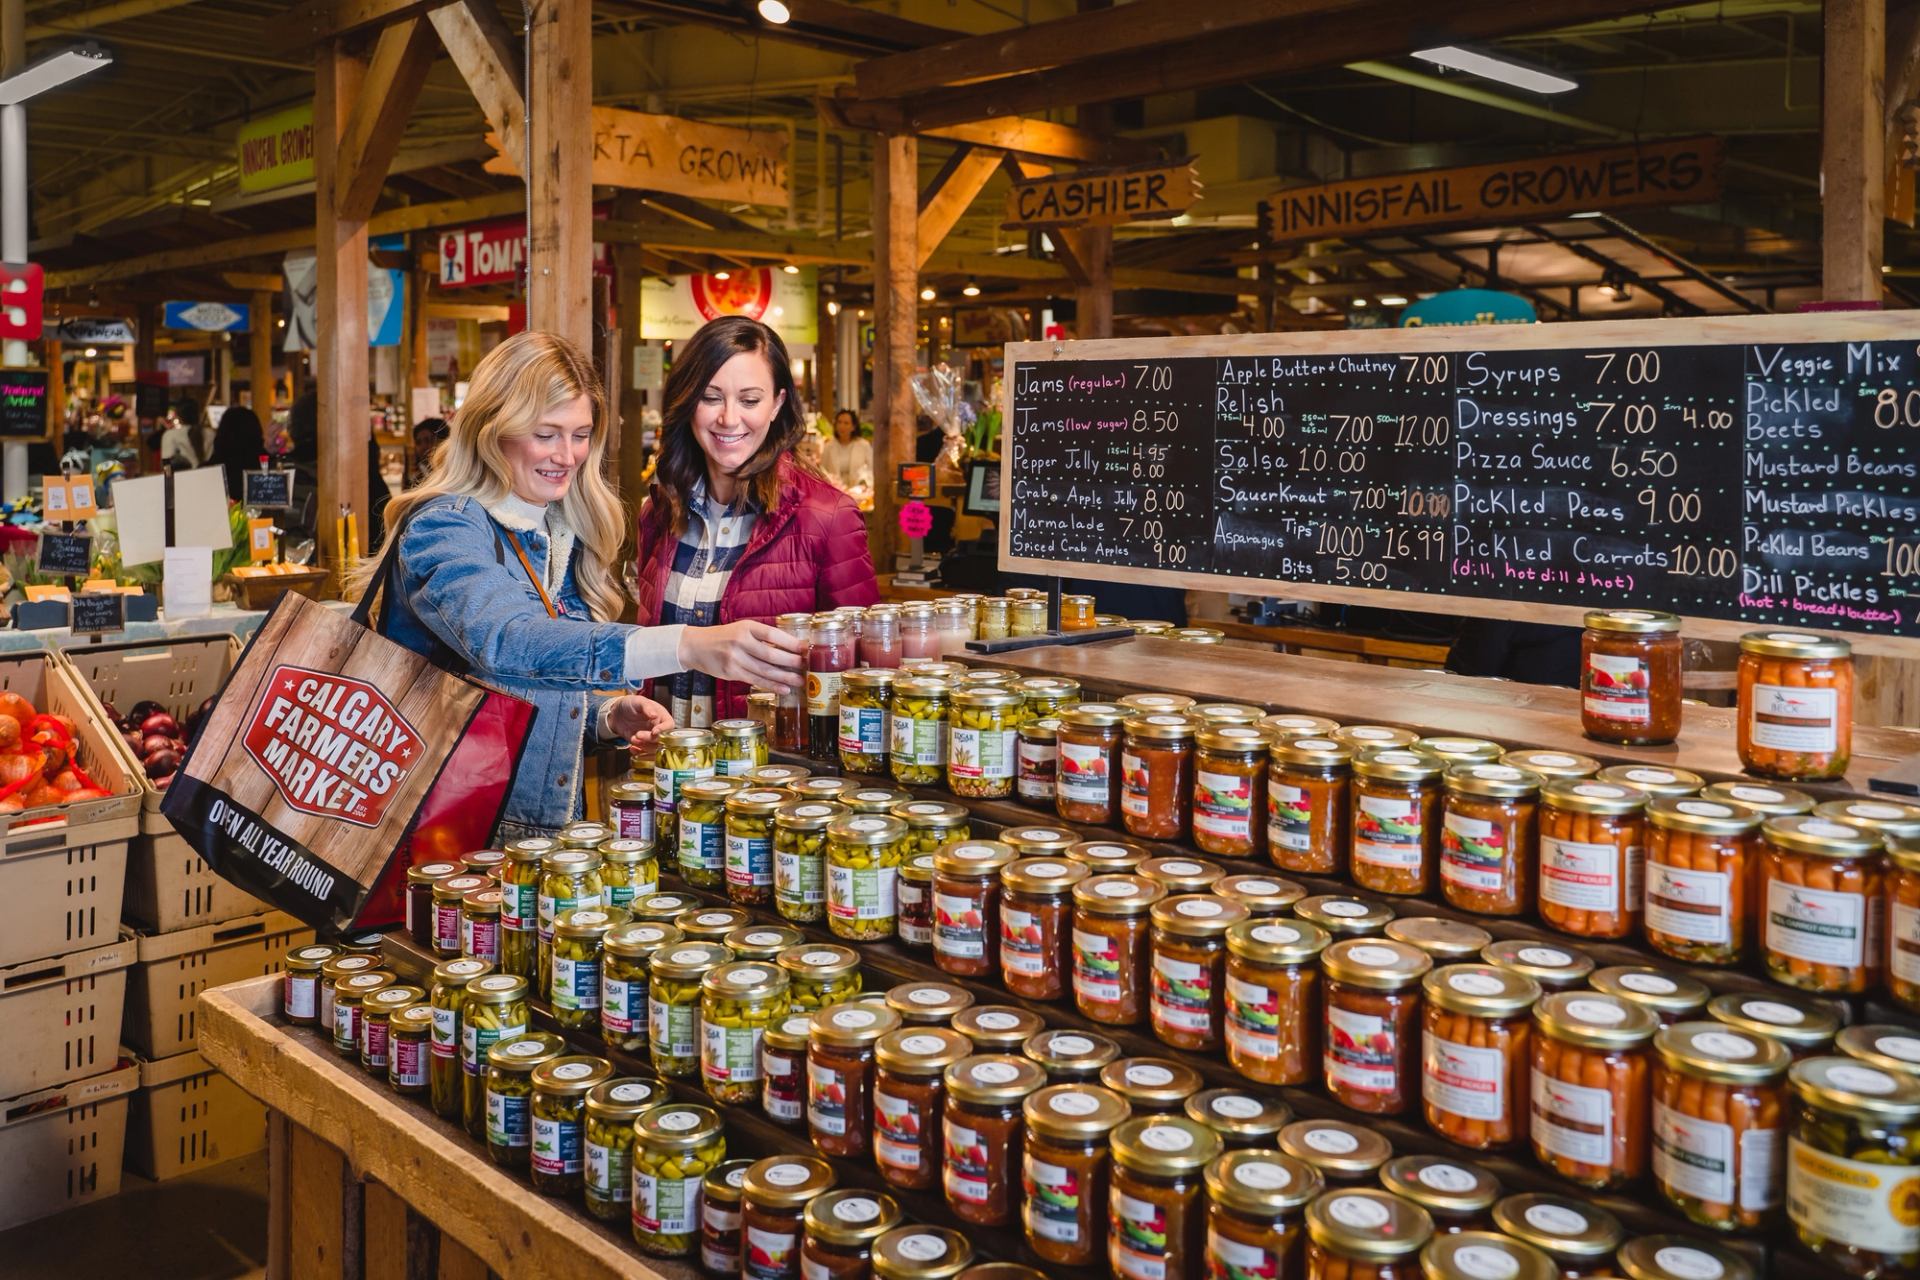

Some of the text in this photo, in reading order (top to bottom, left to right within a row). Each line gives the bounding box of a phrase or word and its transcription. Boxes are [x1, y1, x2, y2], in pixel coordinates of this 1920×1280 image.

[281, 124, 314, 166] GROWE
[679, 145, 778, 186] GROWN
[1018, 174, 1169, 220] CASHIER
[1281, 151, 1703, 232] INNISFAIL GROWERS
[468, 232, 528, 277] TOMA
[1222, 359, 1267, 382] Apple
[1273, 358, 1330, 379] Butter
[1339, 357, 1396, 381] Chutney
[1400, 356, 1448, 384] 7.00
[1466, 351, 1660, 389] Syrups 7.00
[1754, 343, 1900, 376] Veggie Mix
[1017, 365, 1172, 395] Jams (regular) 7.00
[1217, 387, 1284, 414] Relish
[1016, 408, 1179, 434] Jams (low sugar) 8.50
[1242, 415, 1285, 438] 4.00
[1330, 415, 1373, 443] 7.00
[1458, 399, 1577, 434] Dressings
[1588, 402, 1656, 433] 7.00
[1683, 408, 1733, 429] 4.00
[1746, 412, 1823, 440] Beets
[1014, 445, 1057, 474] Pepper
[1065, 448, 1099, 475] Jelly
[1132, 447, 1168, 461] 4.95
[1132, 463, 1164, 478] 8.00
[1220, 445, 1366, 472] Salsa 10.00
[1457, 442, 1677, 477] Pizza Sauce 6.50
[1746, 452, 1917, 478] Mustard Beans
[1015, 481, 1185, 512] Crab Apple Jelly 8.00
[1350, 488, 1386, 510] 7.00
[1568, 491, 1624, 521] Peas
[1638, 489, 1701, 524] 9.00
[1745, 490, 1827, 514] Mustard
[1013, 508, 1163, 540] Marmalade 7.00
[1214, 516, 1284, 551] Asparagus
[1013, 534, 1187, 563] Spiced Crab Apples 9.00
[1282, 518, 1312, 539] Tips
[1316, 522, 1364, 556] 10.00
[1382, 528, 1445, 562] 16.99
[1811, 535, 1869, 560] Beans
[1282, 558, 1387, 581] Bits 5.00
[1505, 562, 1535, 580] hot
[1541, 568, 1569, 583] dill
[1573, 537, 1668, 567] Carrots
[1667, 545, 1737, 578] 10.00
[1743, 568, 1782, 594] Dill
[297, 678, 408, 754] CALGARY
[264, 696, 407, 795] FARMERS'
[262, 738, 368, 813] MARKET
[209, 799, 335, 901] OPEN ALL YEAR ROUND
